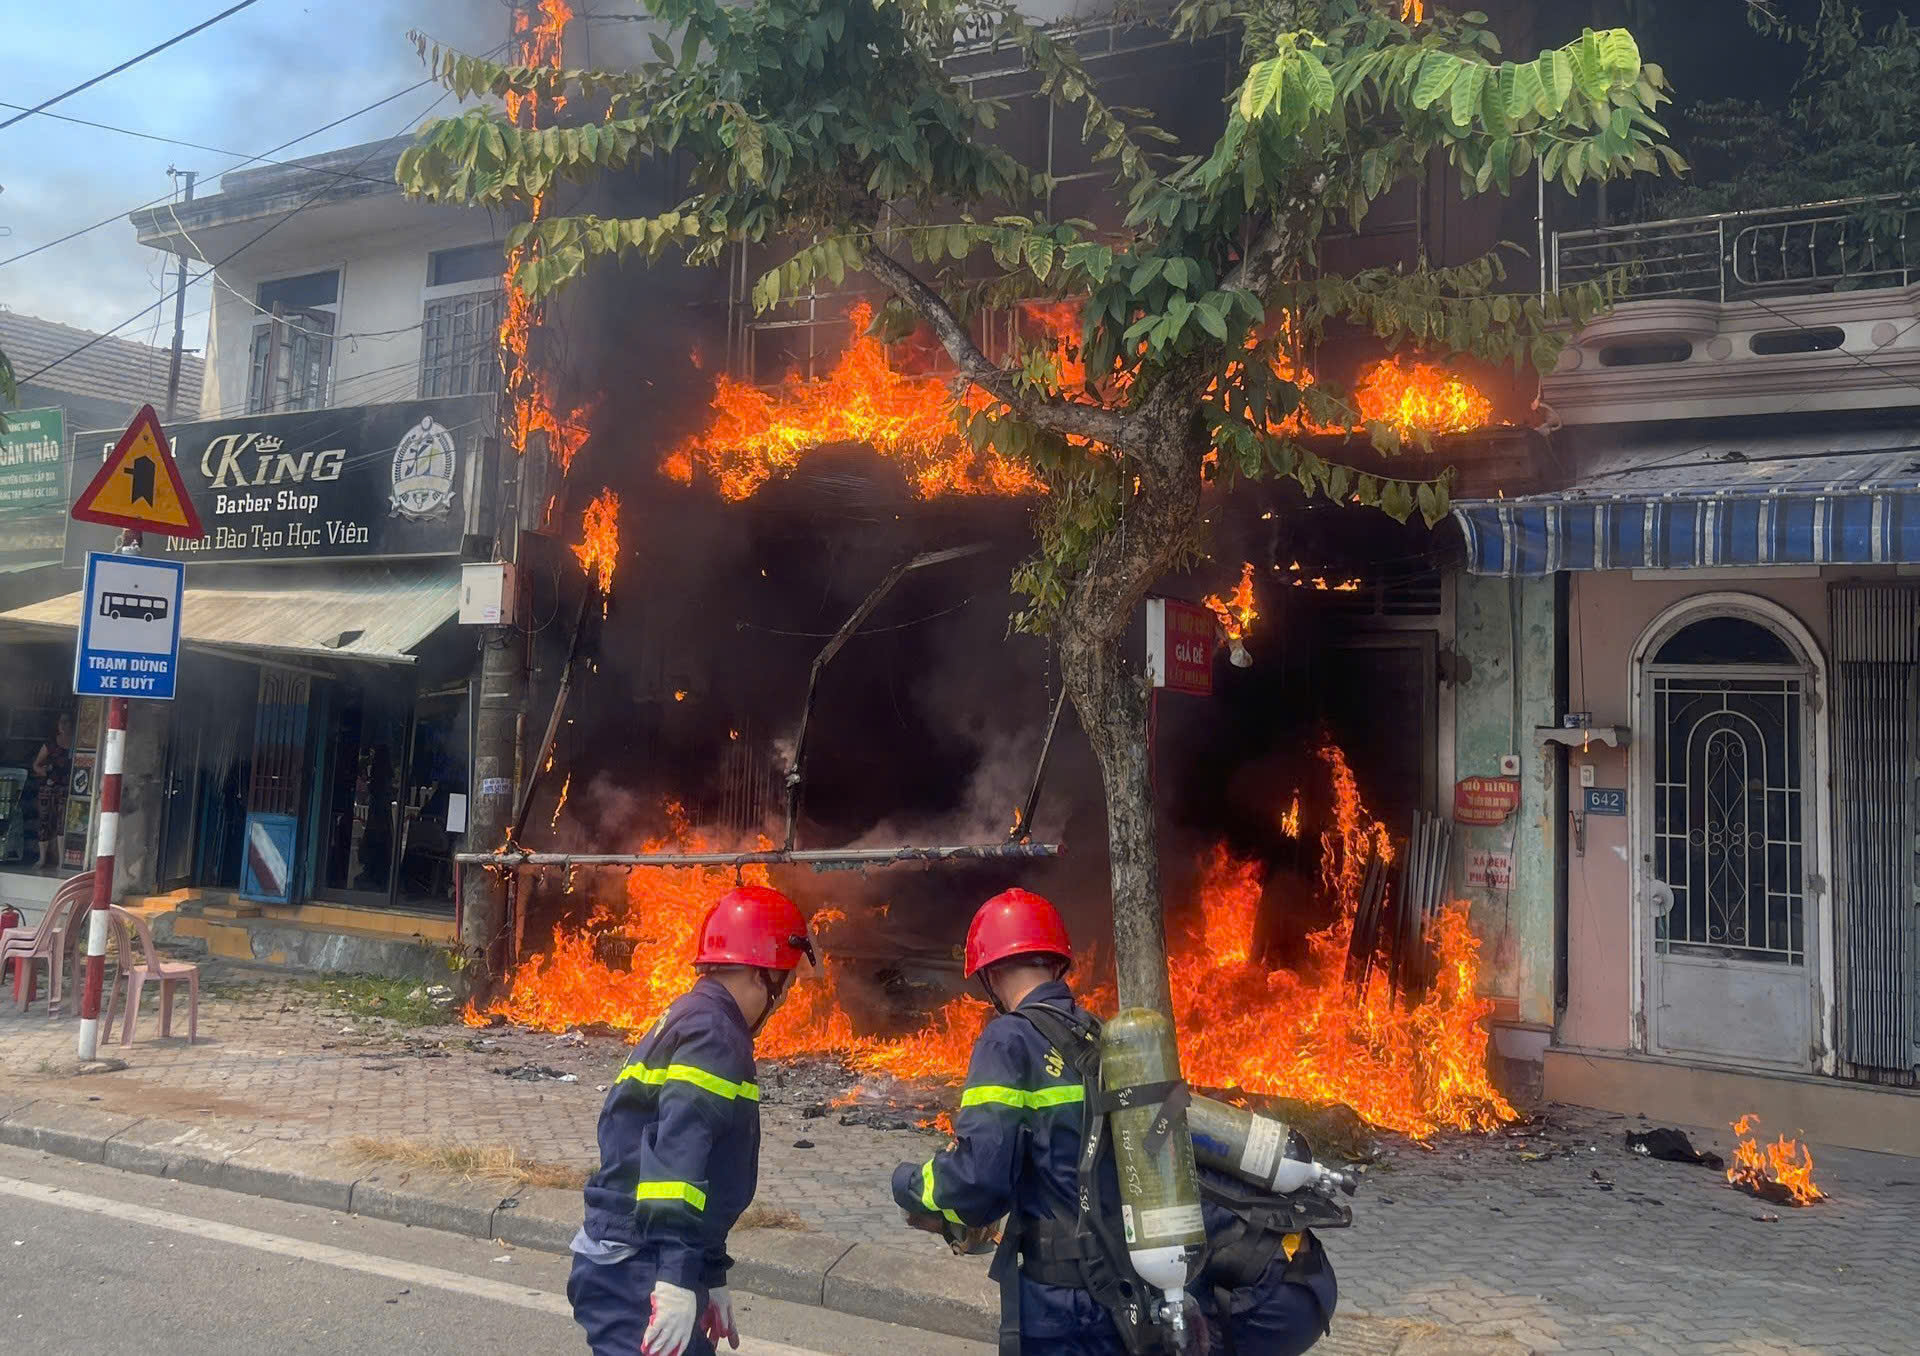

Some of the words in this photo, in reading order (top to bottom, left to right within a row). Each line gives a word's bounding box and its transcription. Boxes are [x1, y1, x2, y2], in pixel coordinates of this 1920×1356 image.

[26, 434, 59, 463] THẢO
[201, 432, 346, 488] KING
[215, 493, 272, 515] Barber
[277, 490, 319, 514] Shop
[215, 526, 247, 550] Đào
[251, 524, 282, 551] Tạo
[286, 522, 321, 549] Học
[326, 520, 369, 545] Viên
[88, 656, 127, 672] TRẠM
[130, 656, 168, 673] DỪNG
[100, 675, 117, 688] XE
[121, 675, 155, 690] BUÝT
[1591, 792, 1620, 807] 642
